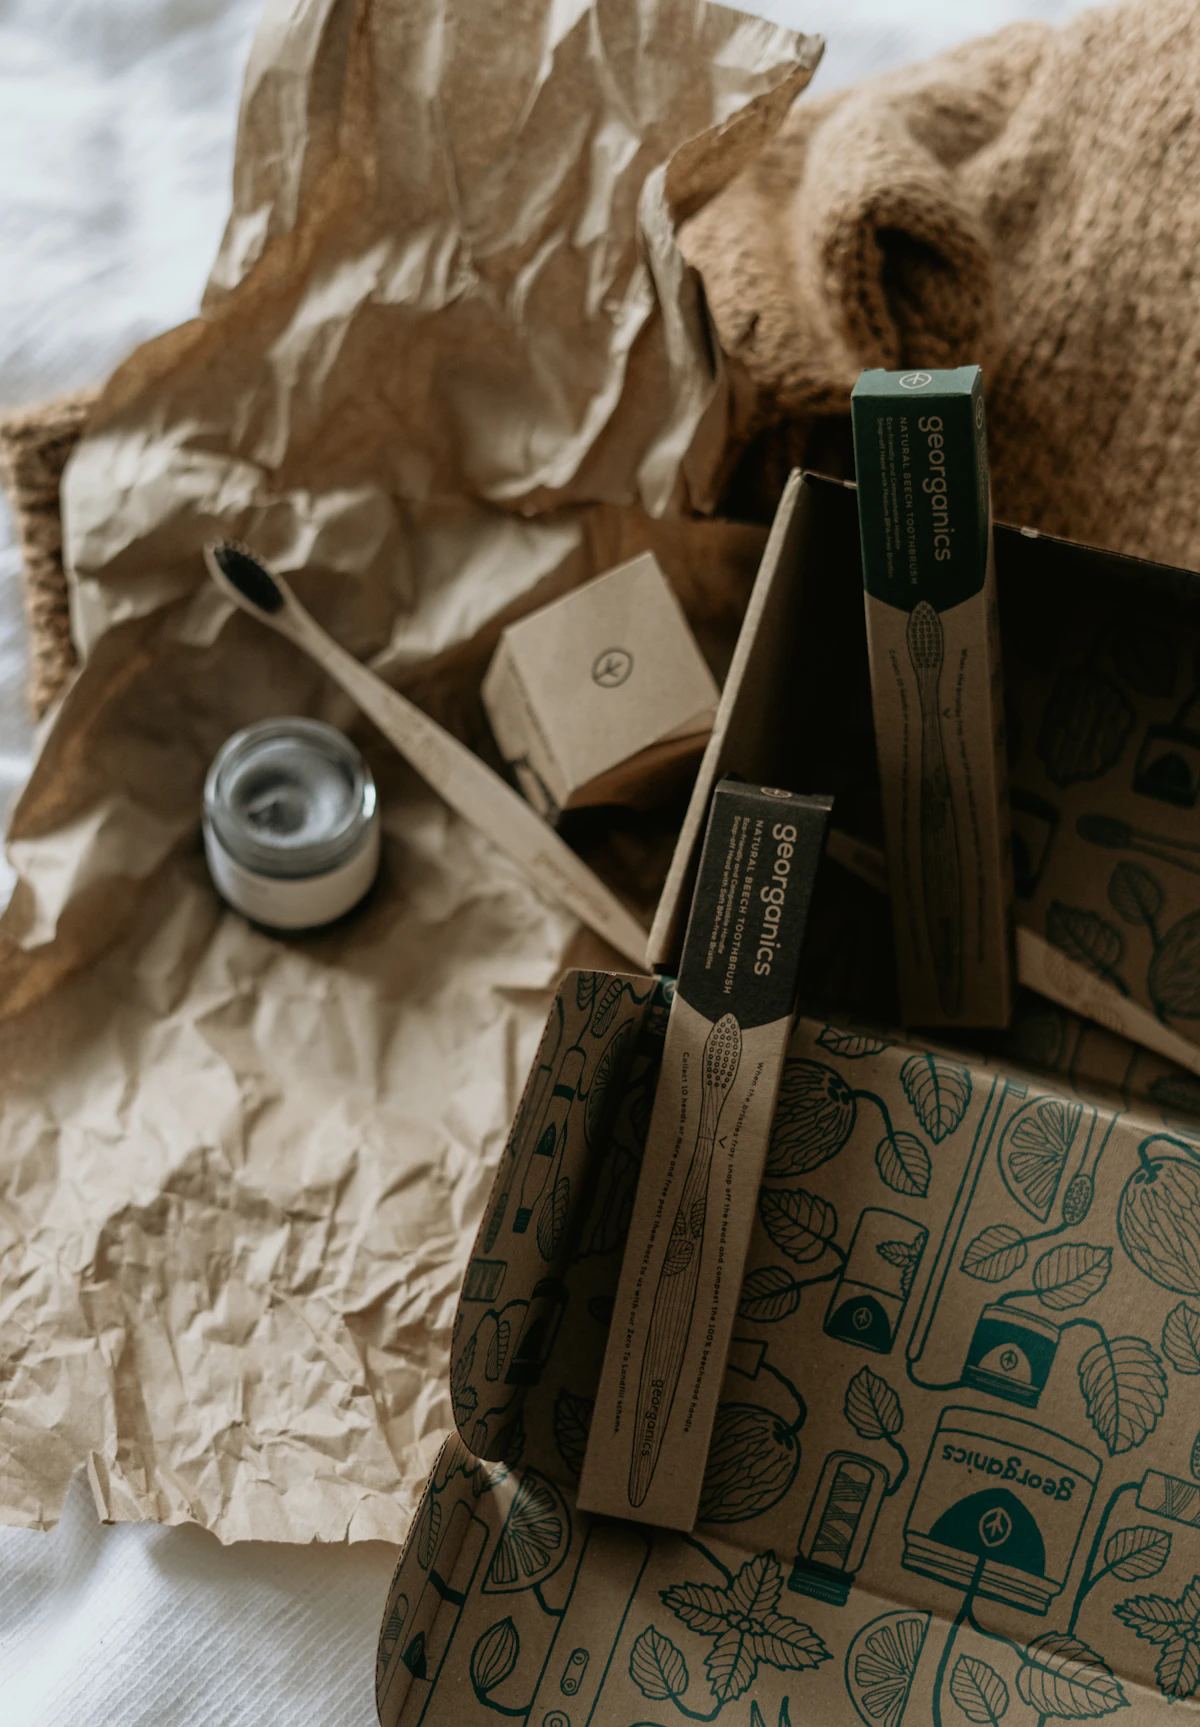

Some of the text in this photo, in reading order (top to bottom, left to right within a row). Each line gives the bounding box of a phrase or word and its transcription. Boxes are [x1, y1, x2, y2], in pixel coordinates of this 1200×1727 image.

[876, 417, 885, 449] Snap-off
[885, 416, 894, 459] Eco-friendly
[918, 414, 954, 561] georganics
[881, 488, 889, 516] Medium
[889, 477, 899, 523] Compostable
[899, 416, 917, 584] NATURAL BEECH TOOTHBRUSH
[883, 517, 891, 550] BPA-free
[734, 817, 749, 862] Eco-friendly
[704, 815, 740, 969] Snap-off Head with Soft BPA-free Bristles
[722, 878, 737, 926] Compostable
[753, 823, 797, 976] georganics
[722, 819, 763, 994] NATURAL BEECH TOOTHBRUSH
[717, 927, 727, 954] Handle
[681, 1051, 689, 1082] Collect
[751, 1062, 764, 1086] When
[681, 1085, 688, 1095] 10
[744, 1089, 754, 1102] the
[678, 1125, 684, 1134] or
[732, 1104, 749, 1137] bristles
[671, 1137, 681, 1158] more
[667, 1160, 676, 1176] and
[725, 1164, 734, 1185] snap
[661, 1179, 671, 1196] free
[724, 1187, 732, 1201] off
[655, 1199, 664, 1217] post
[649, 1220, 660, 1241] them
[720, 1220, 730, 1243] head
[642, 1243, 654, 1263] back
[717, 1246, 725, 1263] and
[636, 1277, 642, 1287] us
[639, 1266, 647, 1275] to
[712, 1265, 722, 1304] compost
[631, 1290, 641, 1308] with
[628, 1311, 636, 1325] our
[710, 1306, 718, 1321] the
[624, 1328, 634, 1348] Zero
[704, 1323, 715, 1347] 100%
[622, 1351, 631, 1361] To
[617, 1364, 629, 1398] Landfill
[691, 1349, 709, 1399] beechwood
[613, 1400, 622, 1435] scheme.
[641, 1379, 664, 1457] georganics
[941, 1444, 1075, 1501] georganics
